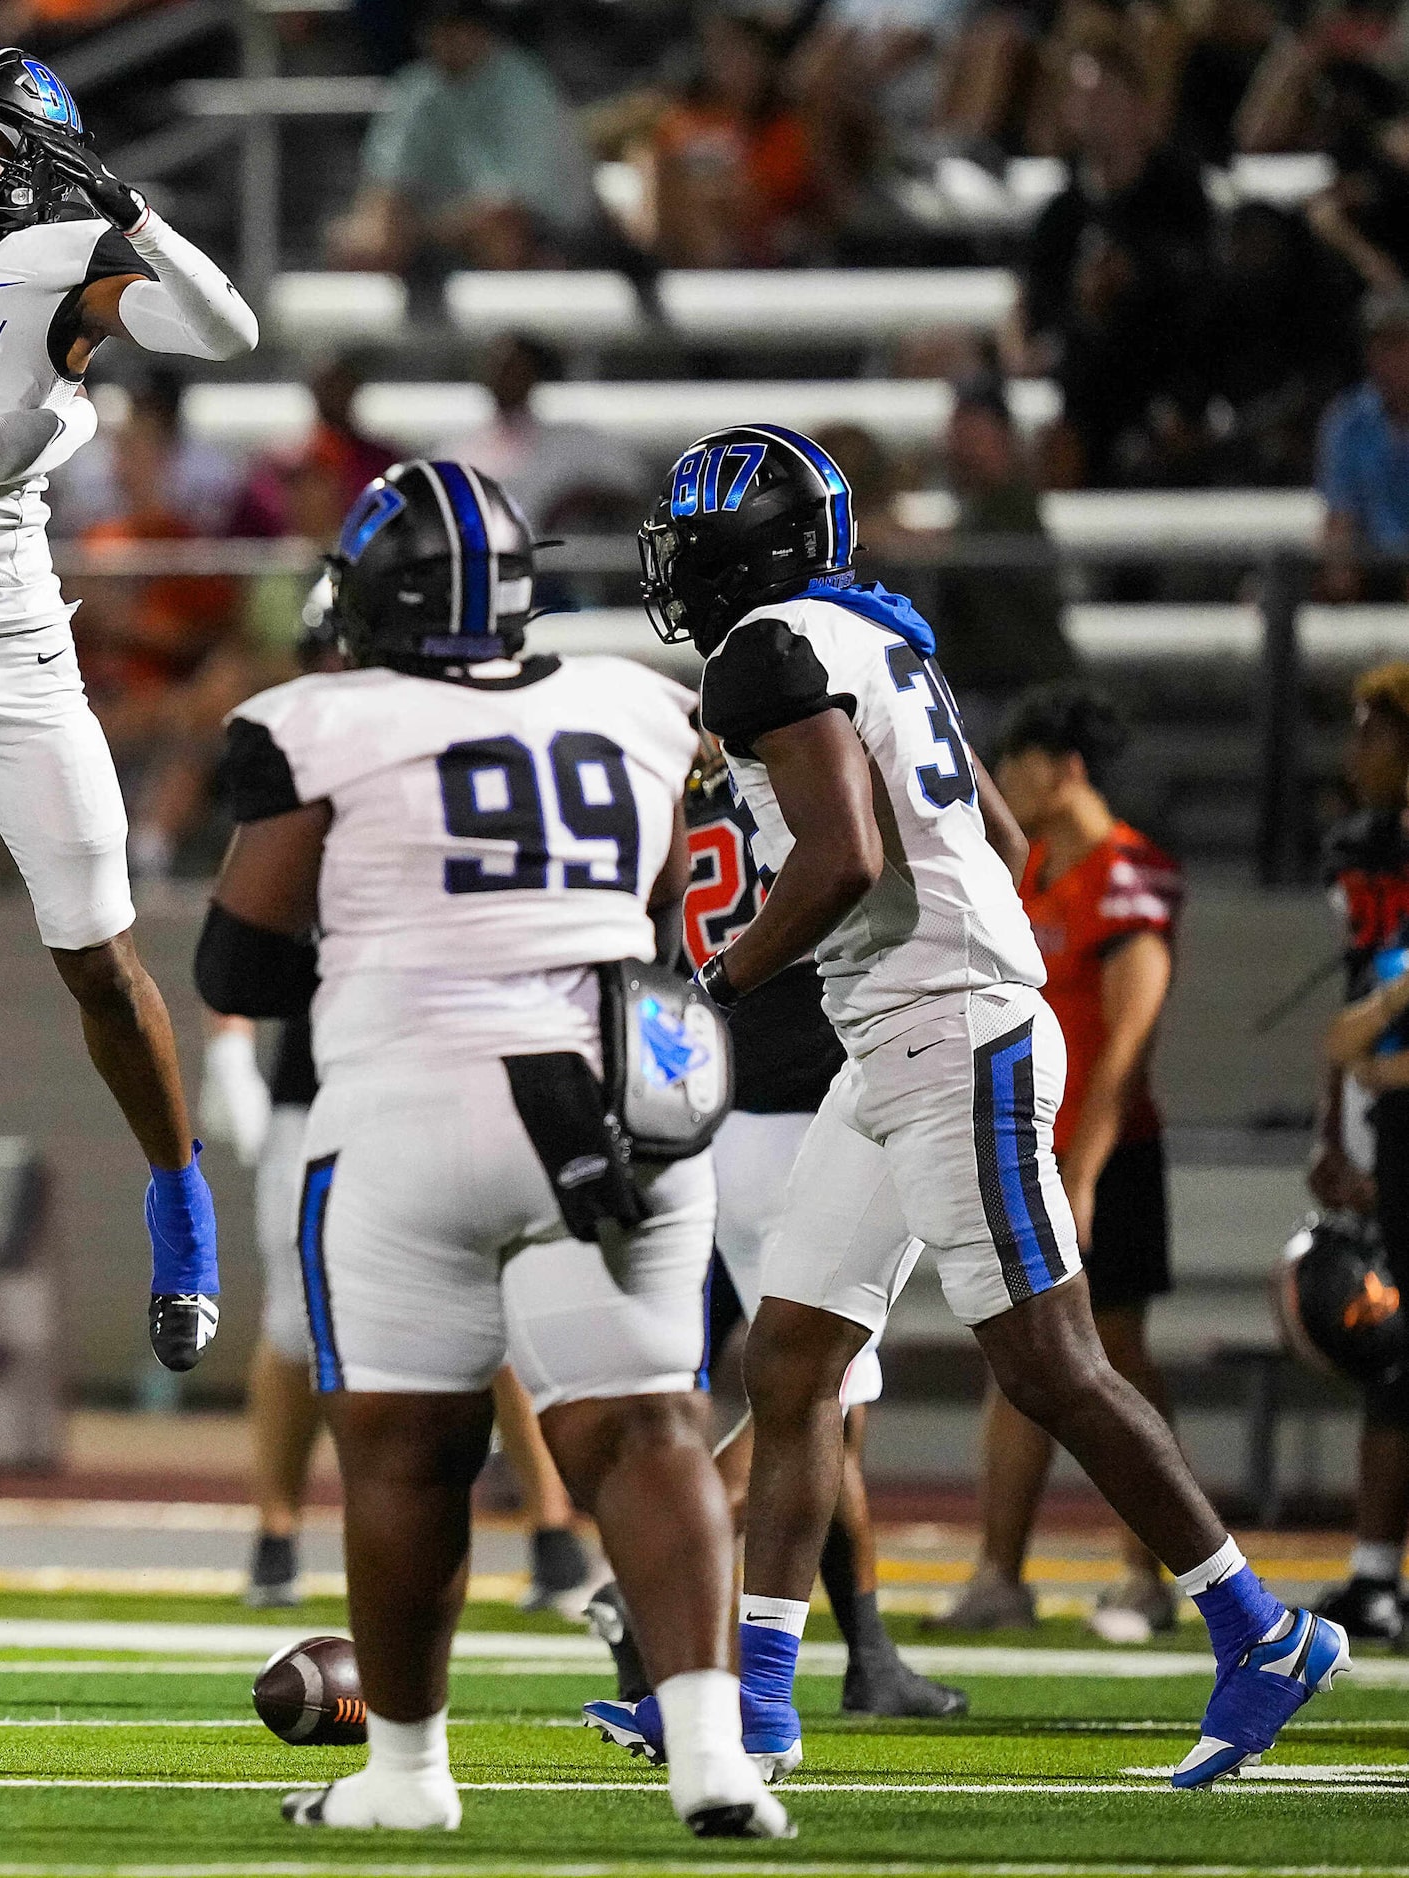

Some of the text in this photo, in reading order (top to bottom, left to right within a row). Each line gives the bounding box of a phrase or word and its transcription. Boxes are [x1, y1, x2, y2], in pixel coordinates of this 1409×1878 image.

[671, 443, 768, 519] 817
[885, 641, 977, 808] 3
[436, 731, 639, 896] 99
[683, 817, 769, 968] 2
